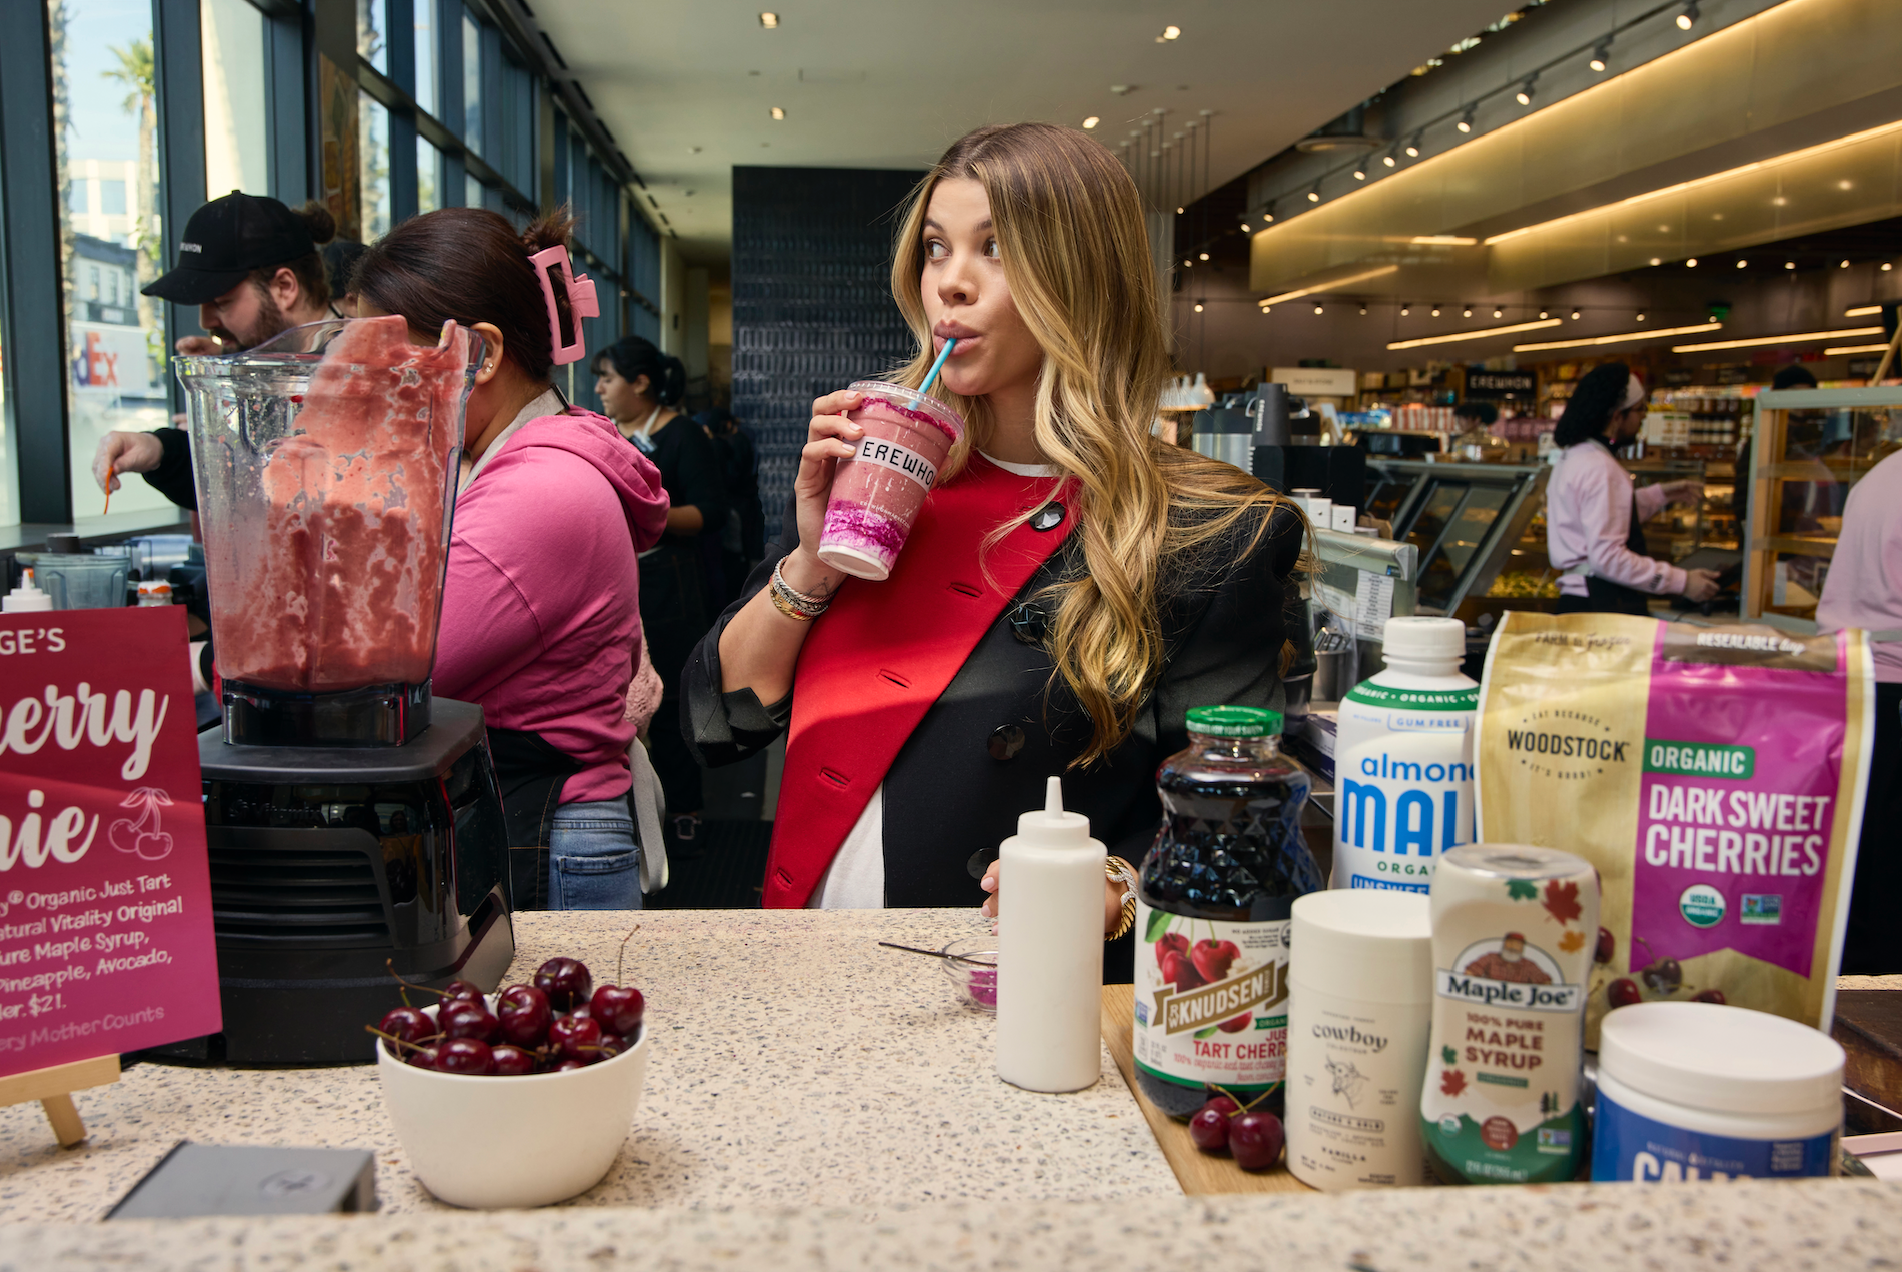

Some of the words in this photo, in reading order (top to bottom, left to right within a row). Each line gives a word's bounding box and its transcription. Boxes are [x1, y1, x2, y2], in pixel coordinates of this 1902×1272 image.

[1469, 375, 1532, 389] EREWHON
[1697, 632, 1777, 651] RESEALABLE
[1779, 638, 1806, 657] bag
[1399, 693, 1458, 703] ORGANIC
[0, 682, 169, 780] erry
[1396, 717, 1425, 727] GUM
[1429, 719, 1460, 728] FREE
[1555, 710, 1600, 727] BECAUSE
[1650, 745, 1746, 774] ORGANIC
[1341, 777, 1478, 857] MAL
[1648, 783, 1726, 827] DARK
[1727, 790, 1831, 832] SWEET
[1644, 823, 1824, 876] CHERRIES
[26, 886, 97, 910] Organic
[99, 881, 135, 899] Just
[136, 873, 172, 893] Tart
[50, 909, 113, 934] Vitality
[116, 896, 183, 922] Original
[34, 935, 92, 961] Maple
[94, 931, 150, 953] Syrup,
[95, 948, 173, 976] Avocado,
[1180, 973, 1264, 1025] KNUDSEN
[1448, 976, 1522, 1004] Maple
[28, 992, 67, 1018] $21.
[1466, 1012, 1502, 1027] 100%
[1505, 1018, 1544, 1031] PURE
[1193, 1040, 1231, 1059] TART
[1312, 1024, 1389, 1053] cowboy
[1465, 1027, 1544, 1050] MAPLE
[1465, 1046, 1542, 1070] SYRUP
